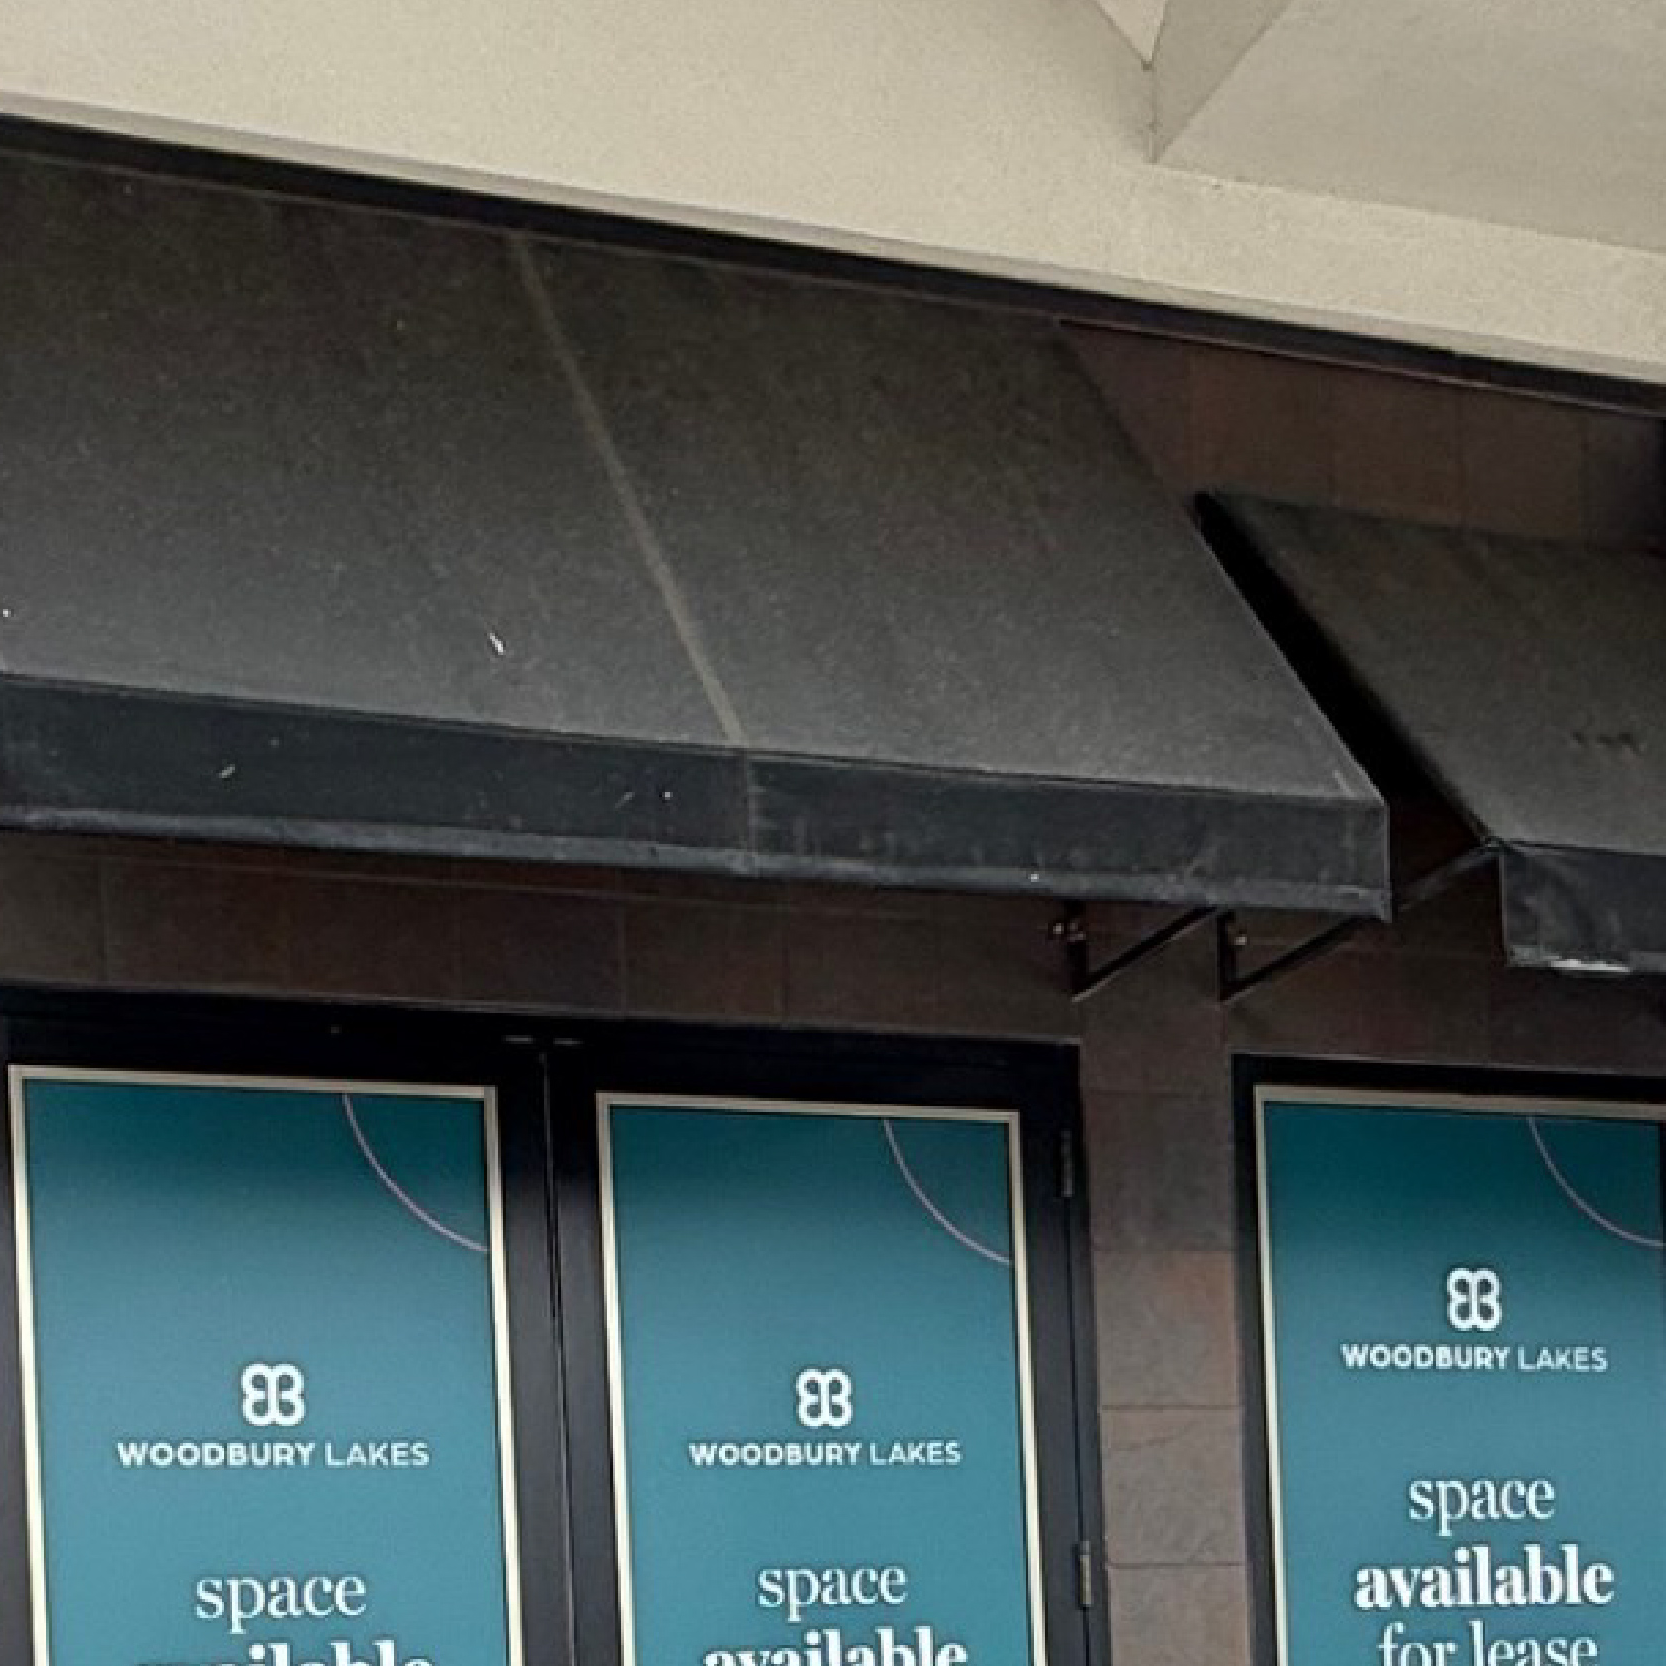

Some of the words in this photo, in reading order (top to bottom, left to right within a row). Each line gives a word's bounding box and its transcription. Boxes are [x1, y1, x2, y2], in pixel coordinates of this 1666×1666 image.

[1341, 1343, 1511, 1371] WOODBURY
[1517, 1346, 1608, 1372] LAKES
[118, 1442, 316, 1466] WOODBURY
[325, 1442, 430, 1466] LAKES
[689, 1442, 863, 1466] WOODBURY
[869, 1441, 961, 1466] LAKES
[1410, 1480, 1555, 1537] space
[759, 1568, 906, 1622] space
[1356, 1543, 1615, 1611] available
[196, 1576, 367, 1635] space
